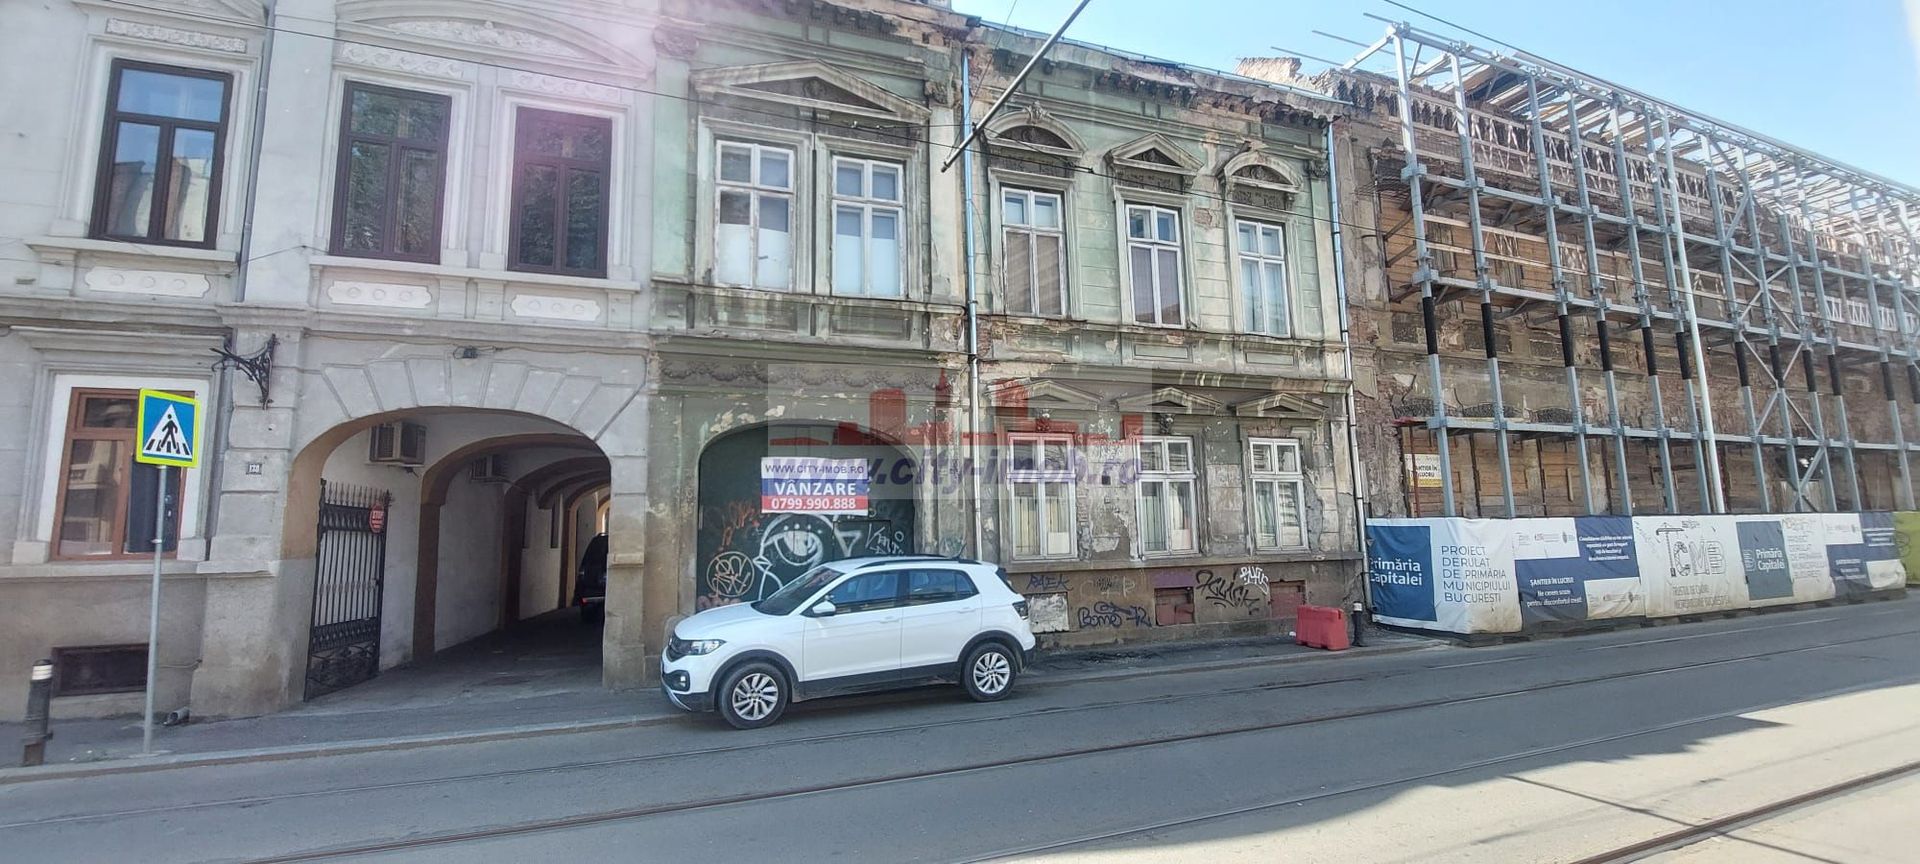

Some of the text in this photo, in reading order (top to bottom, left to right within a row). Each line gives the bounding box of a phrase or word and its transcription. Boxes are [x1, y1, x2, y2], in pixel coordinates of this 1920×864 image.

[765, 464, 864, 475] WWW.CITY-IMOB.RO
[774, 479, 857, 496] VÂNZARE
[771, 496, 857, 510] 0799.990.888
[1441, 545, 1487, 556] PROIECT
[1442, 557, 1491, 568] DERULAT
[1442, 568, 1507, 579] DE PRIMĂRIA
[1443, 580, 1511, 592] MUNICIPIULUI
